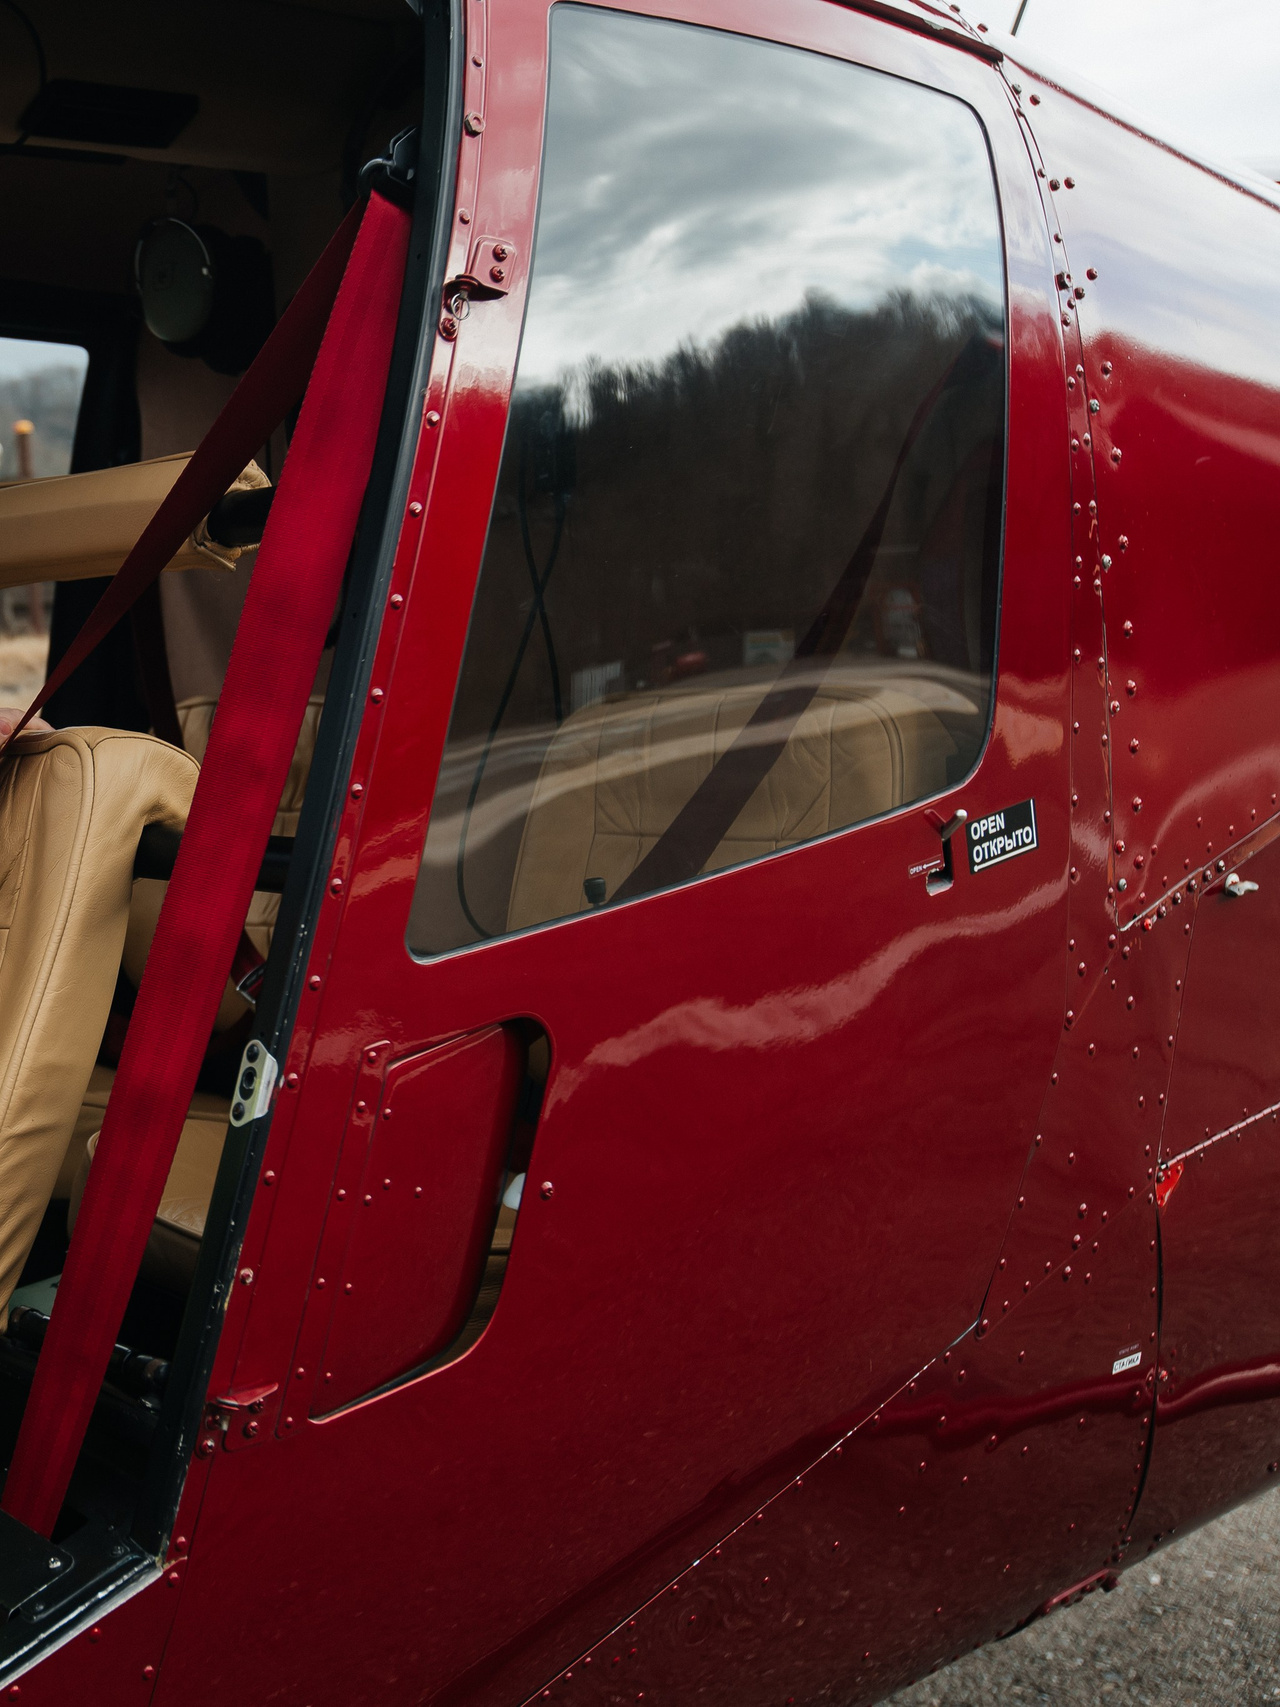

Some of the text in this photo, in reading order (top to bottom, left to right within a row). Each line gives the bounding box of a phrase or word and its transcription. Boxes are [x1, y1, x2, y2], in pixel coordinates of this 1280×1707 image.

[971, 812, 1005, 840] OPEN
[973, 826, 1033, 863] ОТКРЫТО
[910, 865, 923, 875] OPEN
